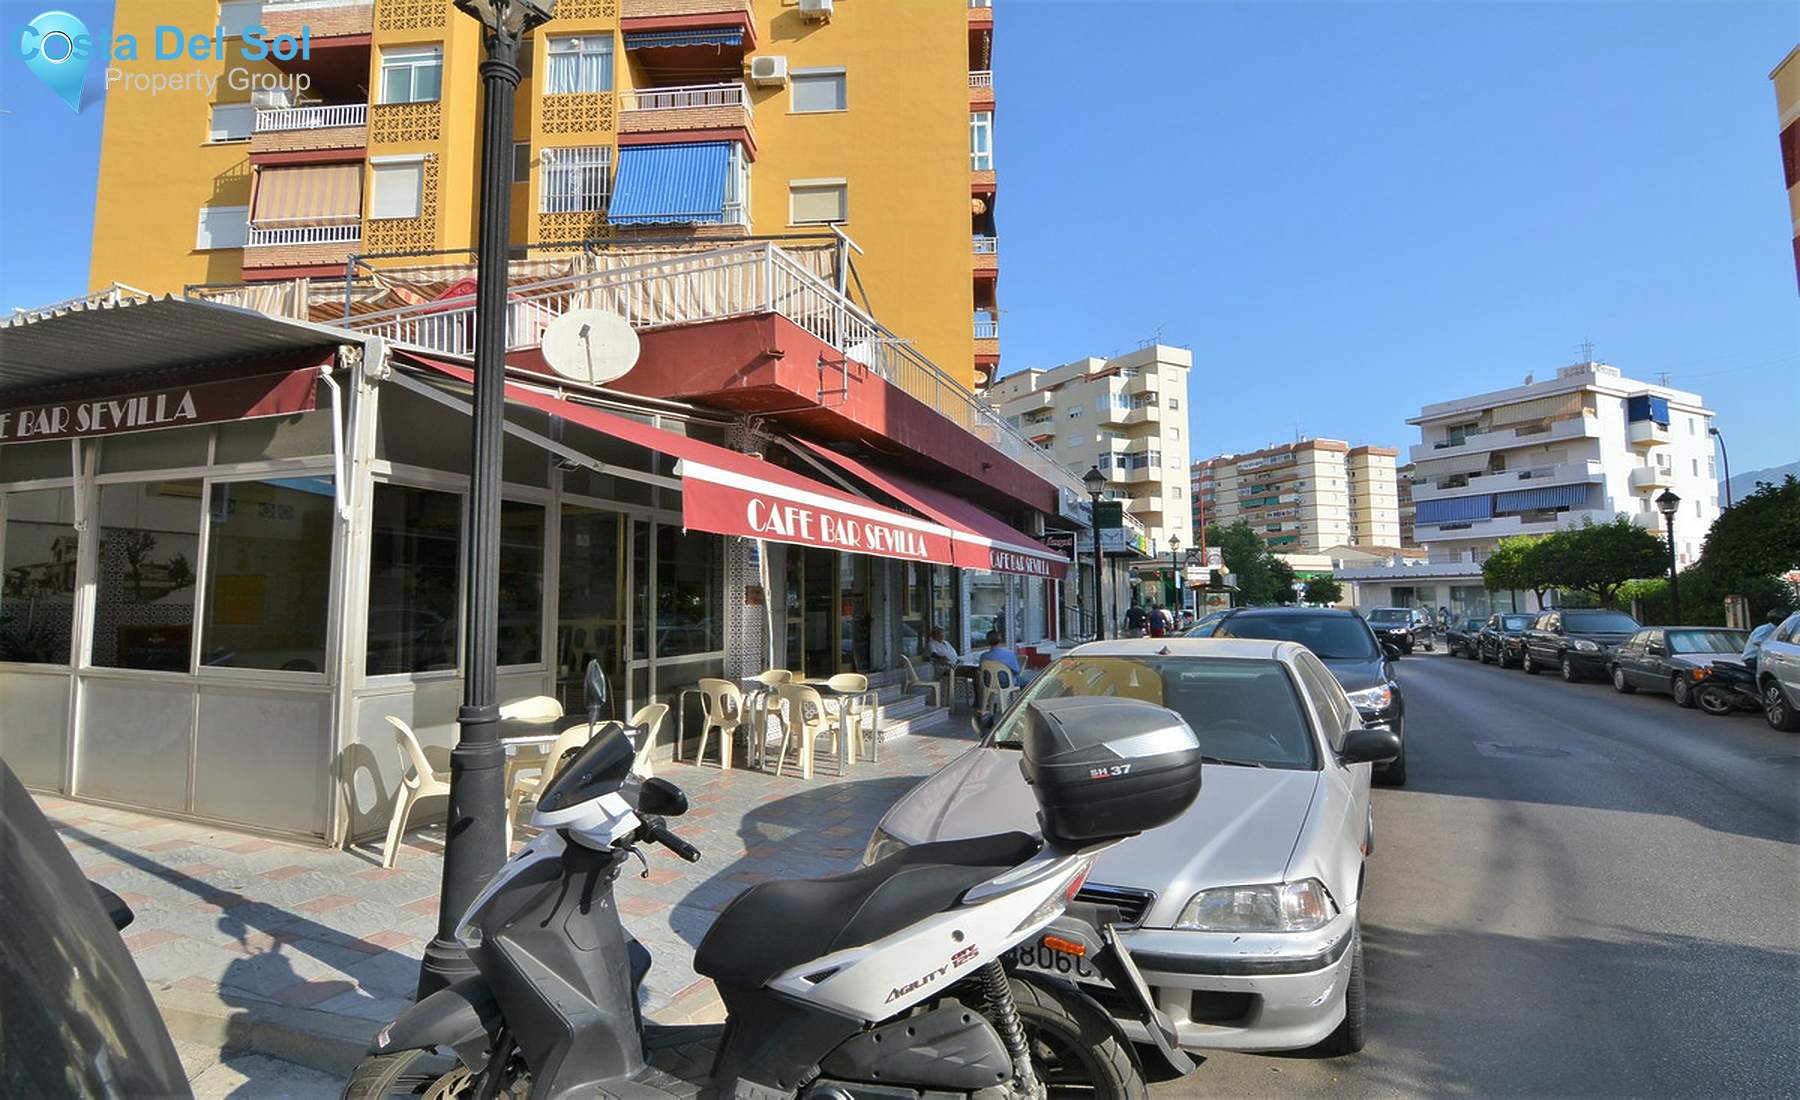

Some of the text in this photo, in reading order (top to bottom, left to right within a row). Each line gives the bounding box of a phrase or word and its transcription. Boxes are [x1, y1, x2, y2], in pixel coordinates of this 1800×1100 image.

[17, 406, 70, 436] BAR
[75, 390, 197, 432] SEVILLA
[747, 499, 928, 558] CAFE BAR SEVILLA
[990, 550, 1050, 575] CAFE BAR SEVILLA
[1090, 764, 1131, 777] SH 37
[884, 947, 980, 1004] AGILITY 125
